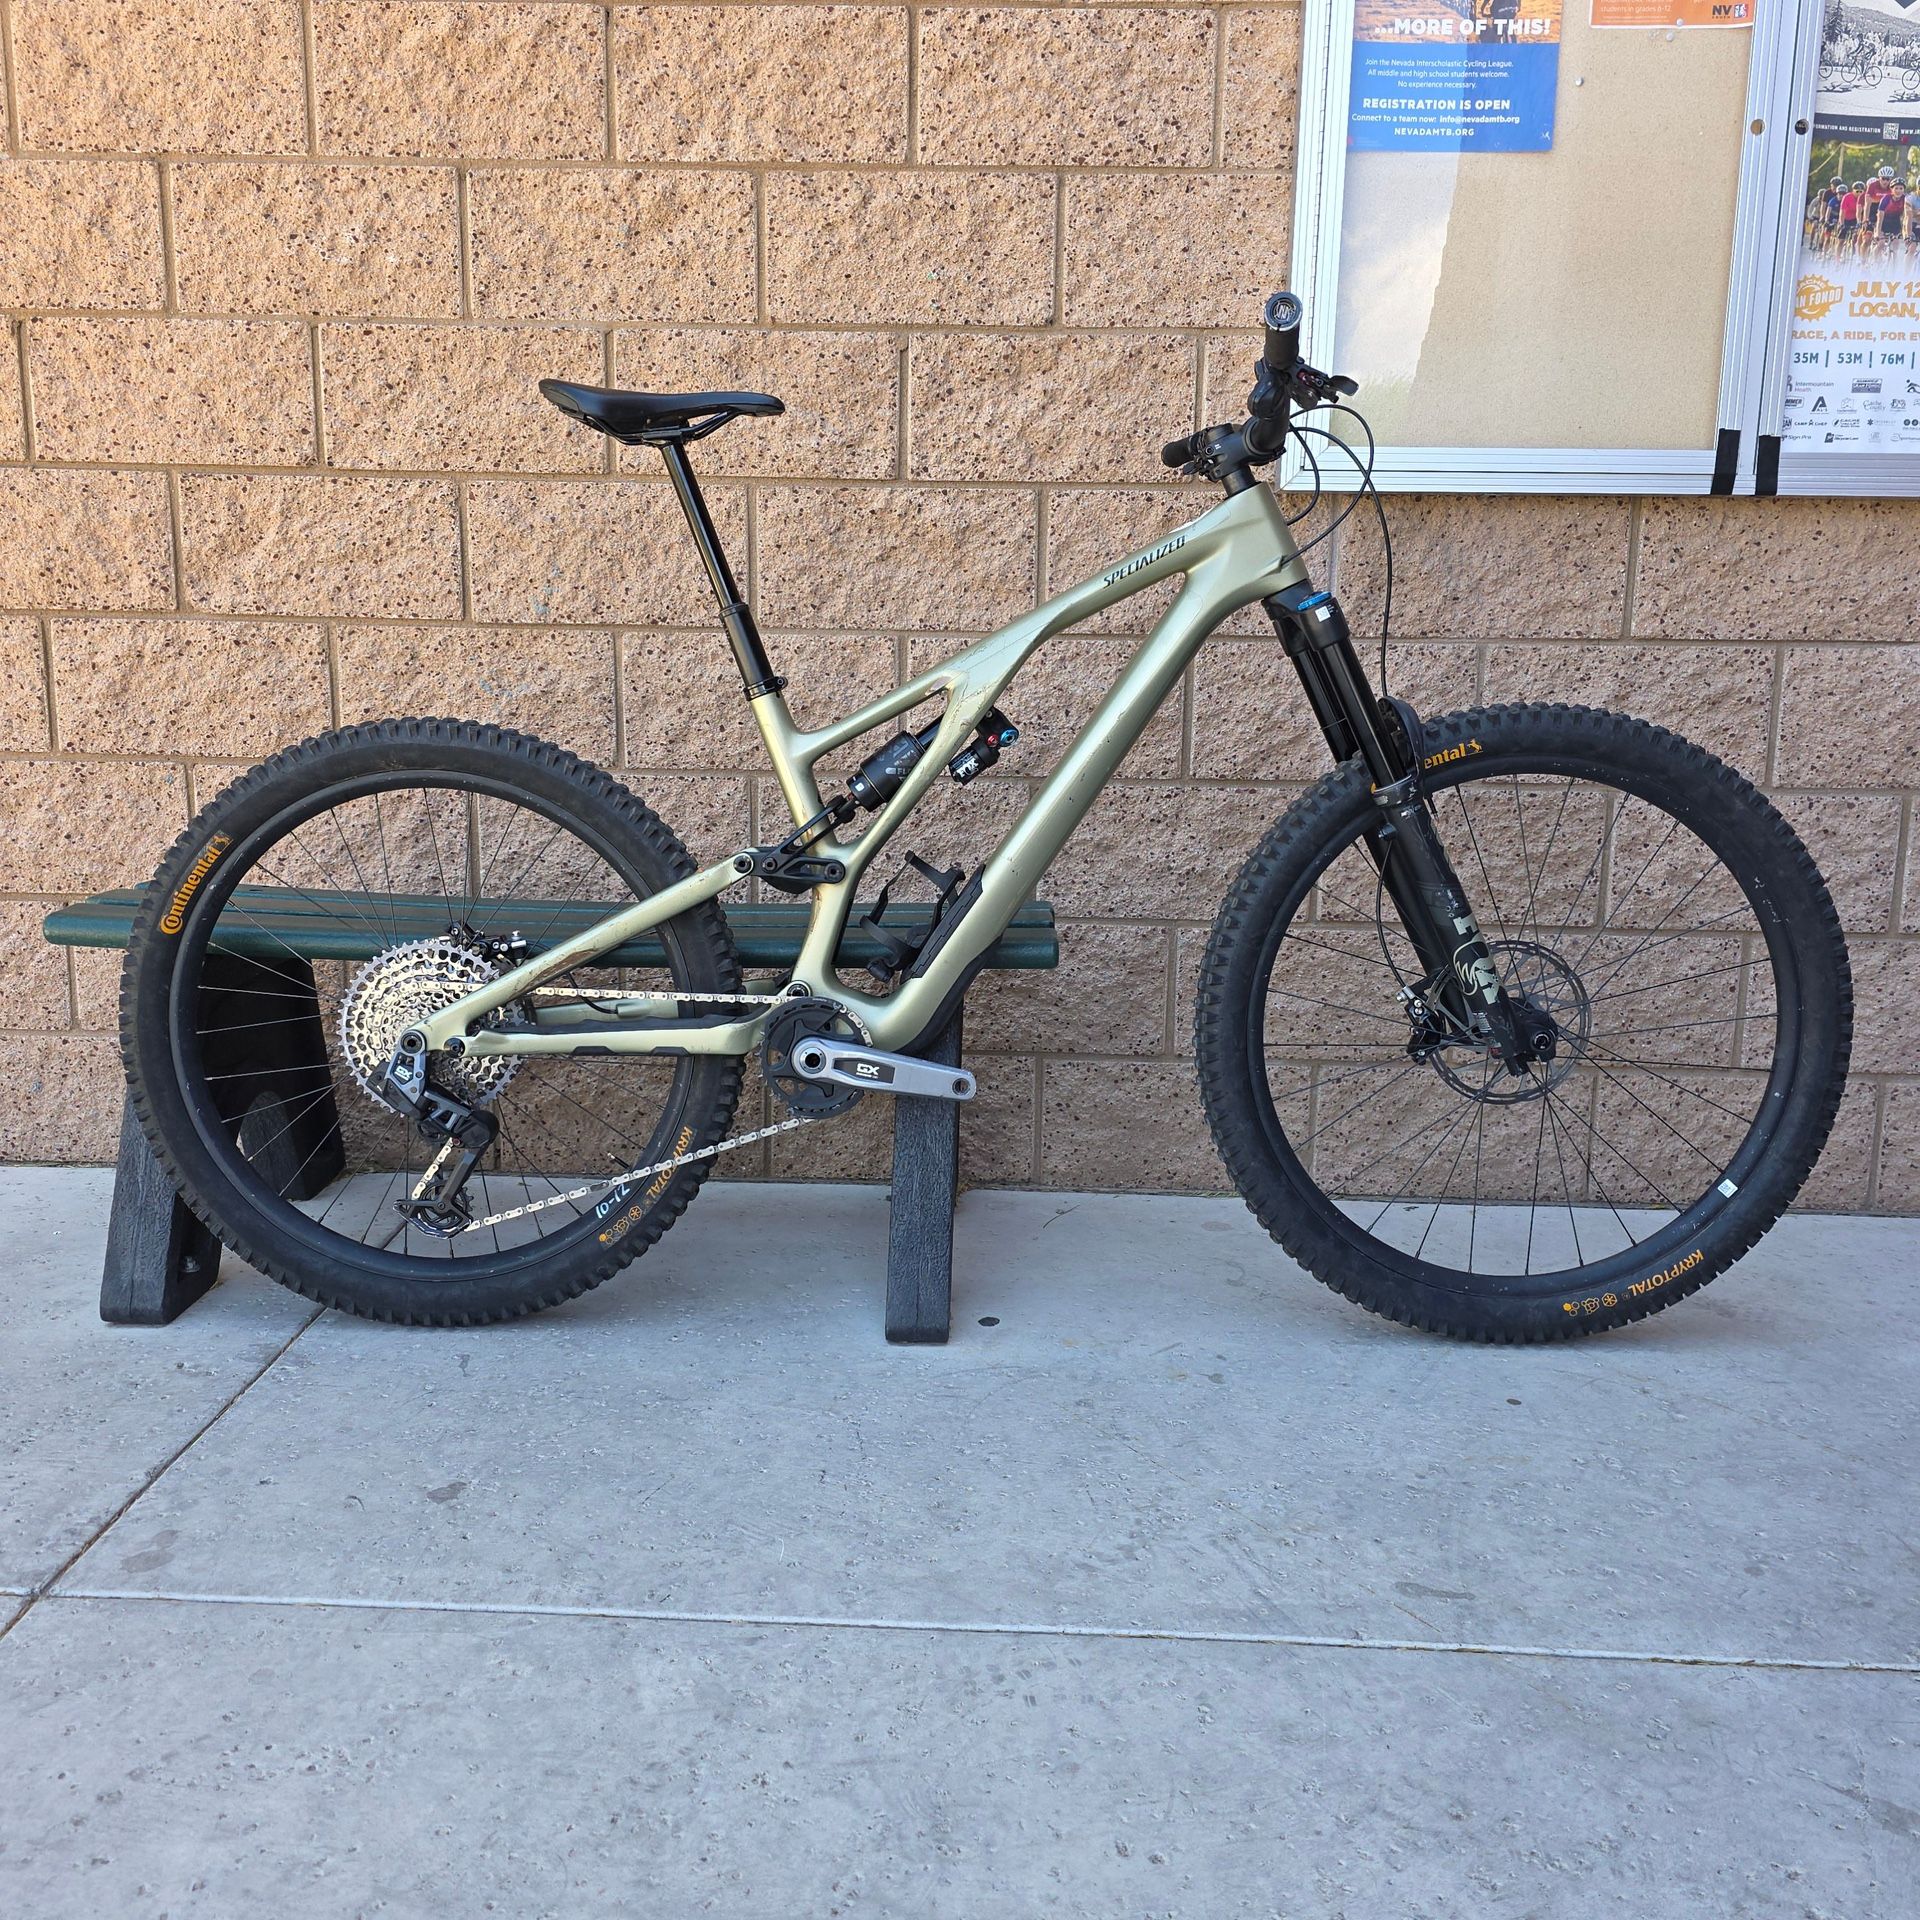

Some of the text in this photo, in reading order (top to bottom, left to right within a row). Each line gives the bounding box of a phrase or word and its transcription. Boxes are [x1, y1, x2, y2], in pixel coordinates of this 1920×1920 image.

[1712, 5, 1732, 15] NV
[1459, 19, 1487, 35] OF
[1494, 19, 1551, 35] THIS!
[1391, 59, 1415, 67] Nevada
[1416, 59, 1462, 67] Interscholastic
[1463, 60, 1487, 68] Cycling
[1488, 60, 1514, 68] League.
[1414, 70, 1428, 78] high
[1408, 81, 1443, 89] experience
[1444, 82, 1477, 90] necessary.
[1363, 98, 1511, 111] REGISTRATION IS OPEN
[1352, 113, 1381, 121] Connect
[1440, 115, 1520, 125] info@nevadamtb.org
[1394, 127, 1475, 136] NEVADAMTB.ORG
[1849, 126, 1881, 134] REGISTRATION
[1850, 281, 1902, 298] JULY
[1808, 288, 1841, 306] FONDO
[1849, 302, 1920, 321] LOGAN,
[1831, 331, 1840, 340] A
[1843, 331, 1877, 342] RIDE,
[1880, 332, 1906, 341] FOR
[1793, 352, 1905, 365] 35M 53M 76M
[1103, 535, 1186, 589] SPECIALIZED
[956, 757, 979, 778] FOX
[160, 844, 223, 934] Continental
[857, 1063, 879, 1075] GX
[1627, 1249, 1704, 1297] KRYPTOTAL
